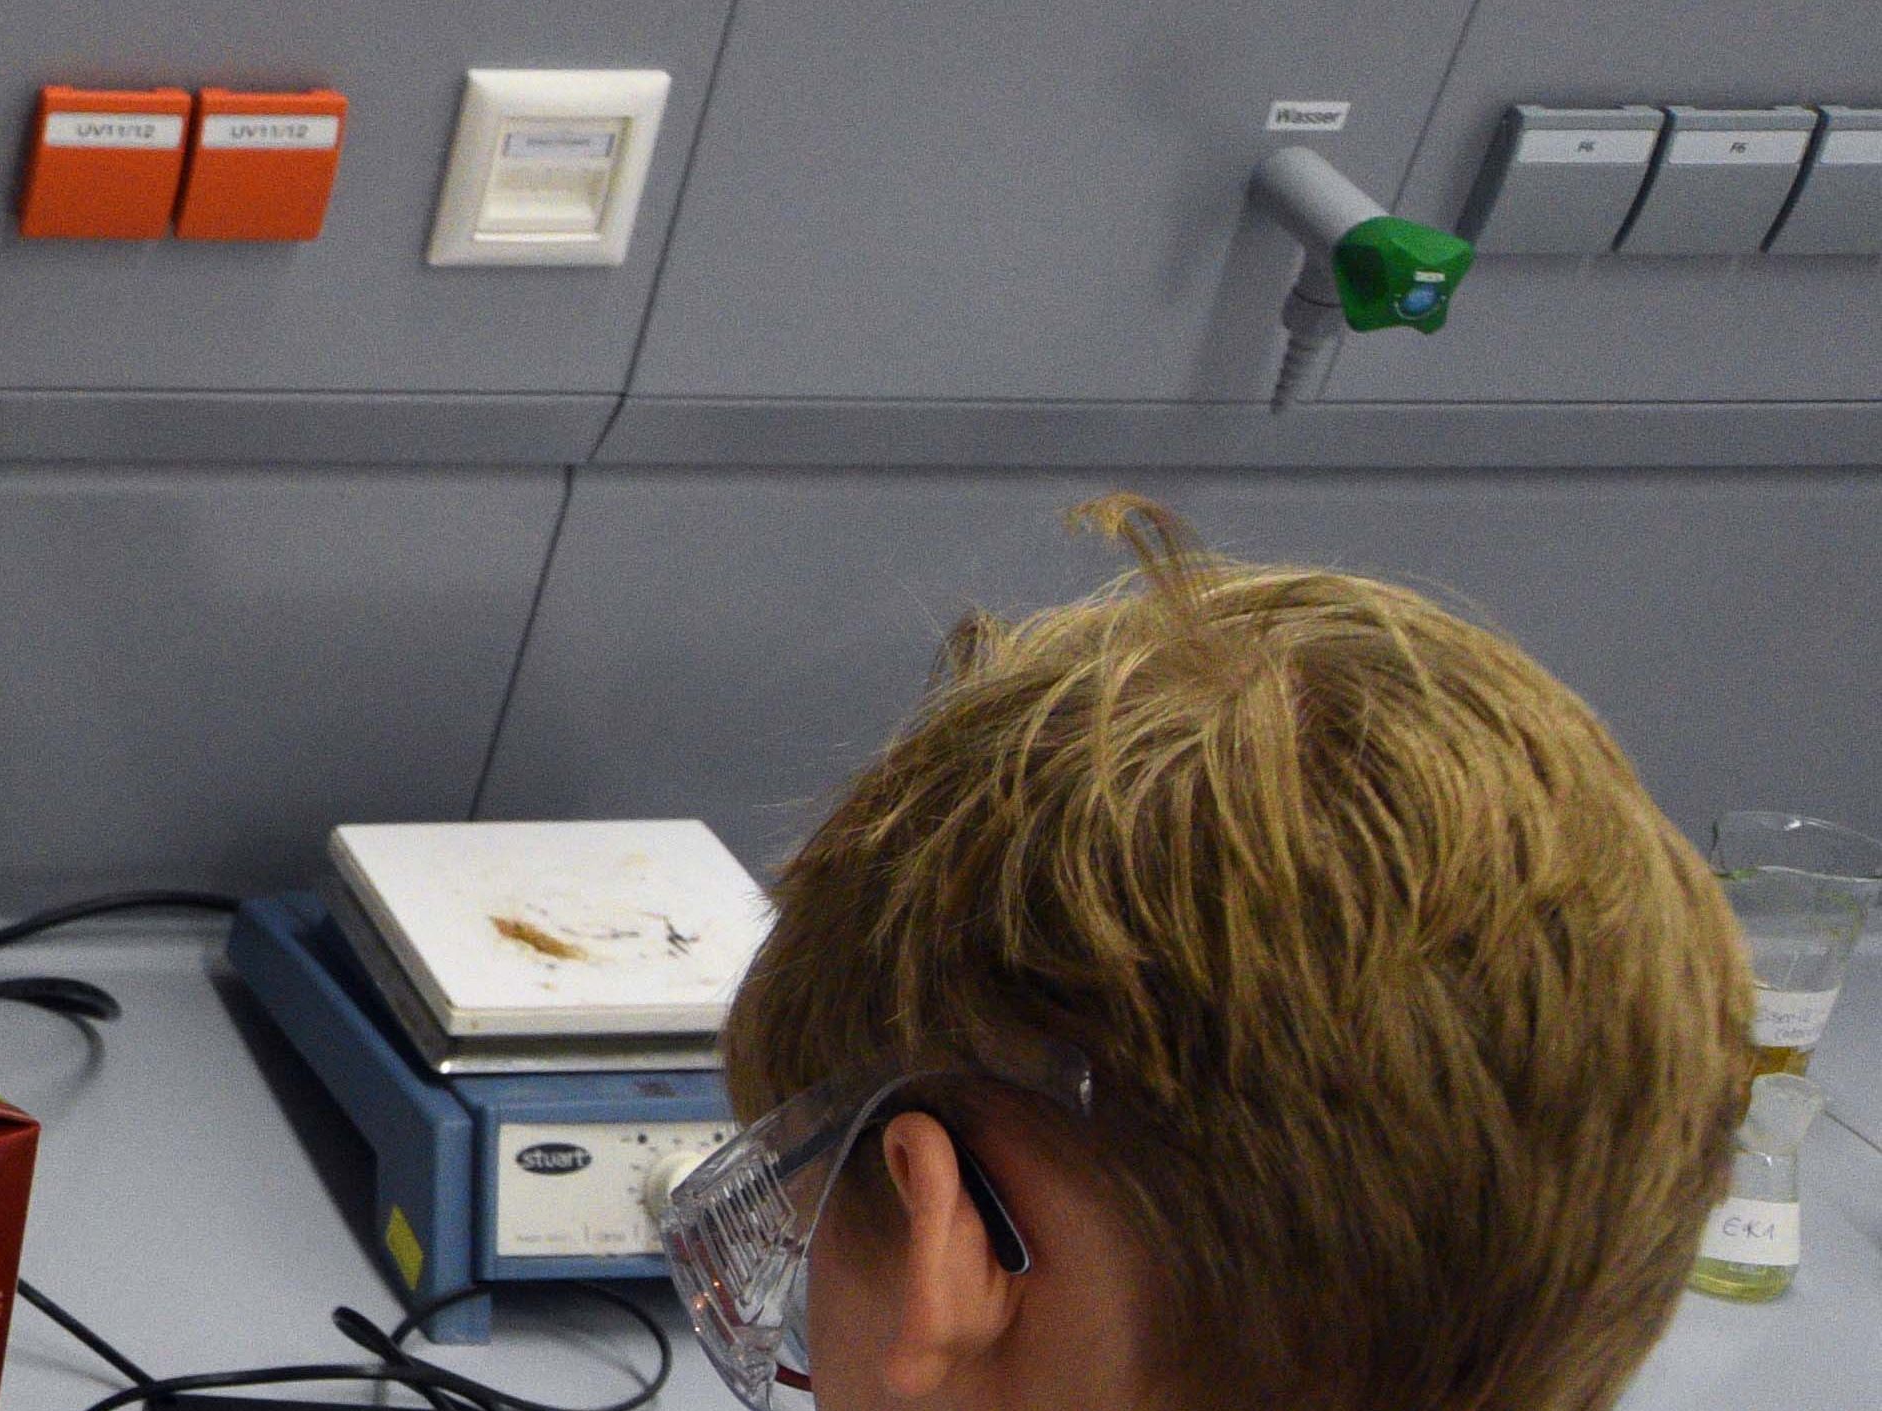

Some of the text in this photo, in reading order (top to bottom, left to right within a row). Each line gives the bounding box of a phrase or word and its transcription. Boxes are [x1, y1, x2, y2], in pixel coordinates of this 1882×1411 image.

[1277, 108, 1341, 125] Wasser
[77, 122, 157, 139] UV11/12
[230, 123, 310, 140] UV11/12
[523, 1149, 585, 1169] stuart
